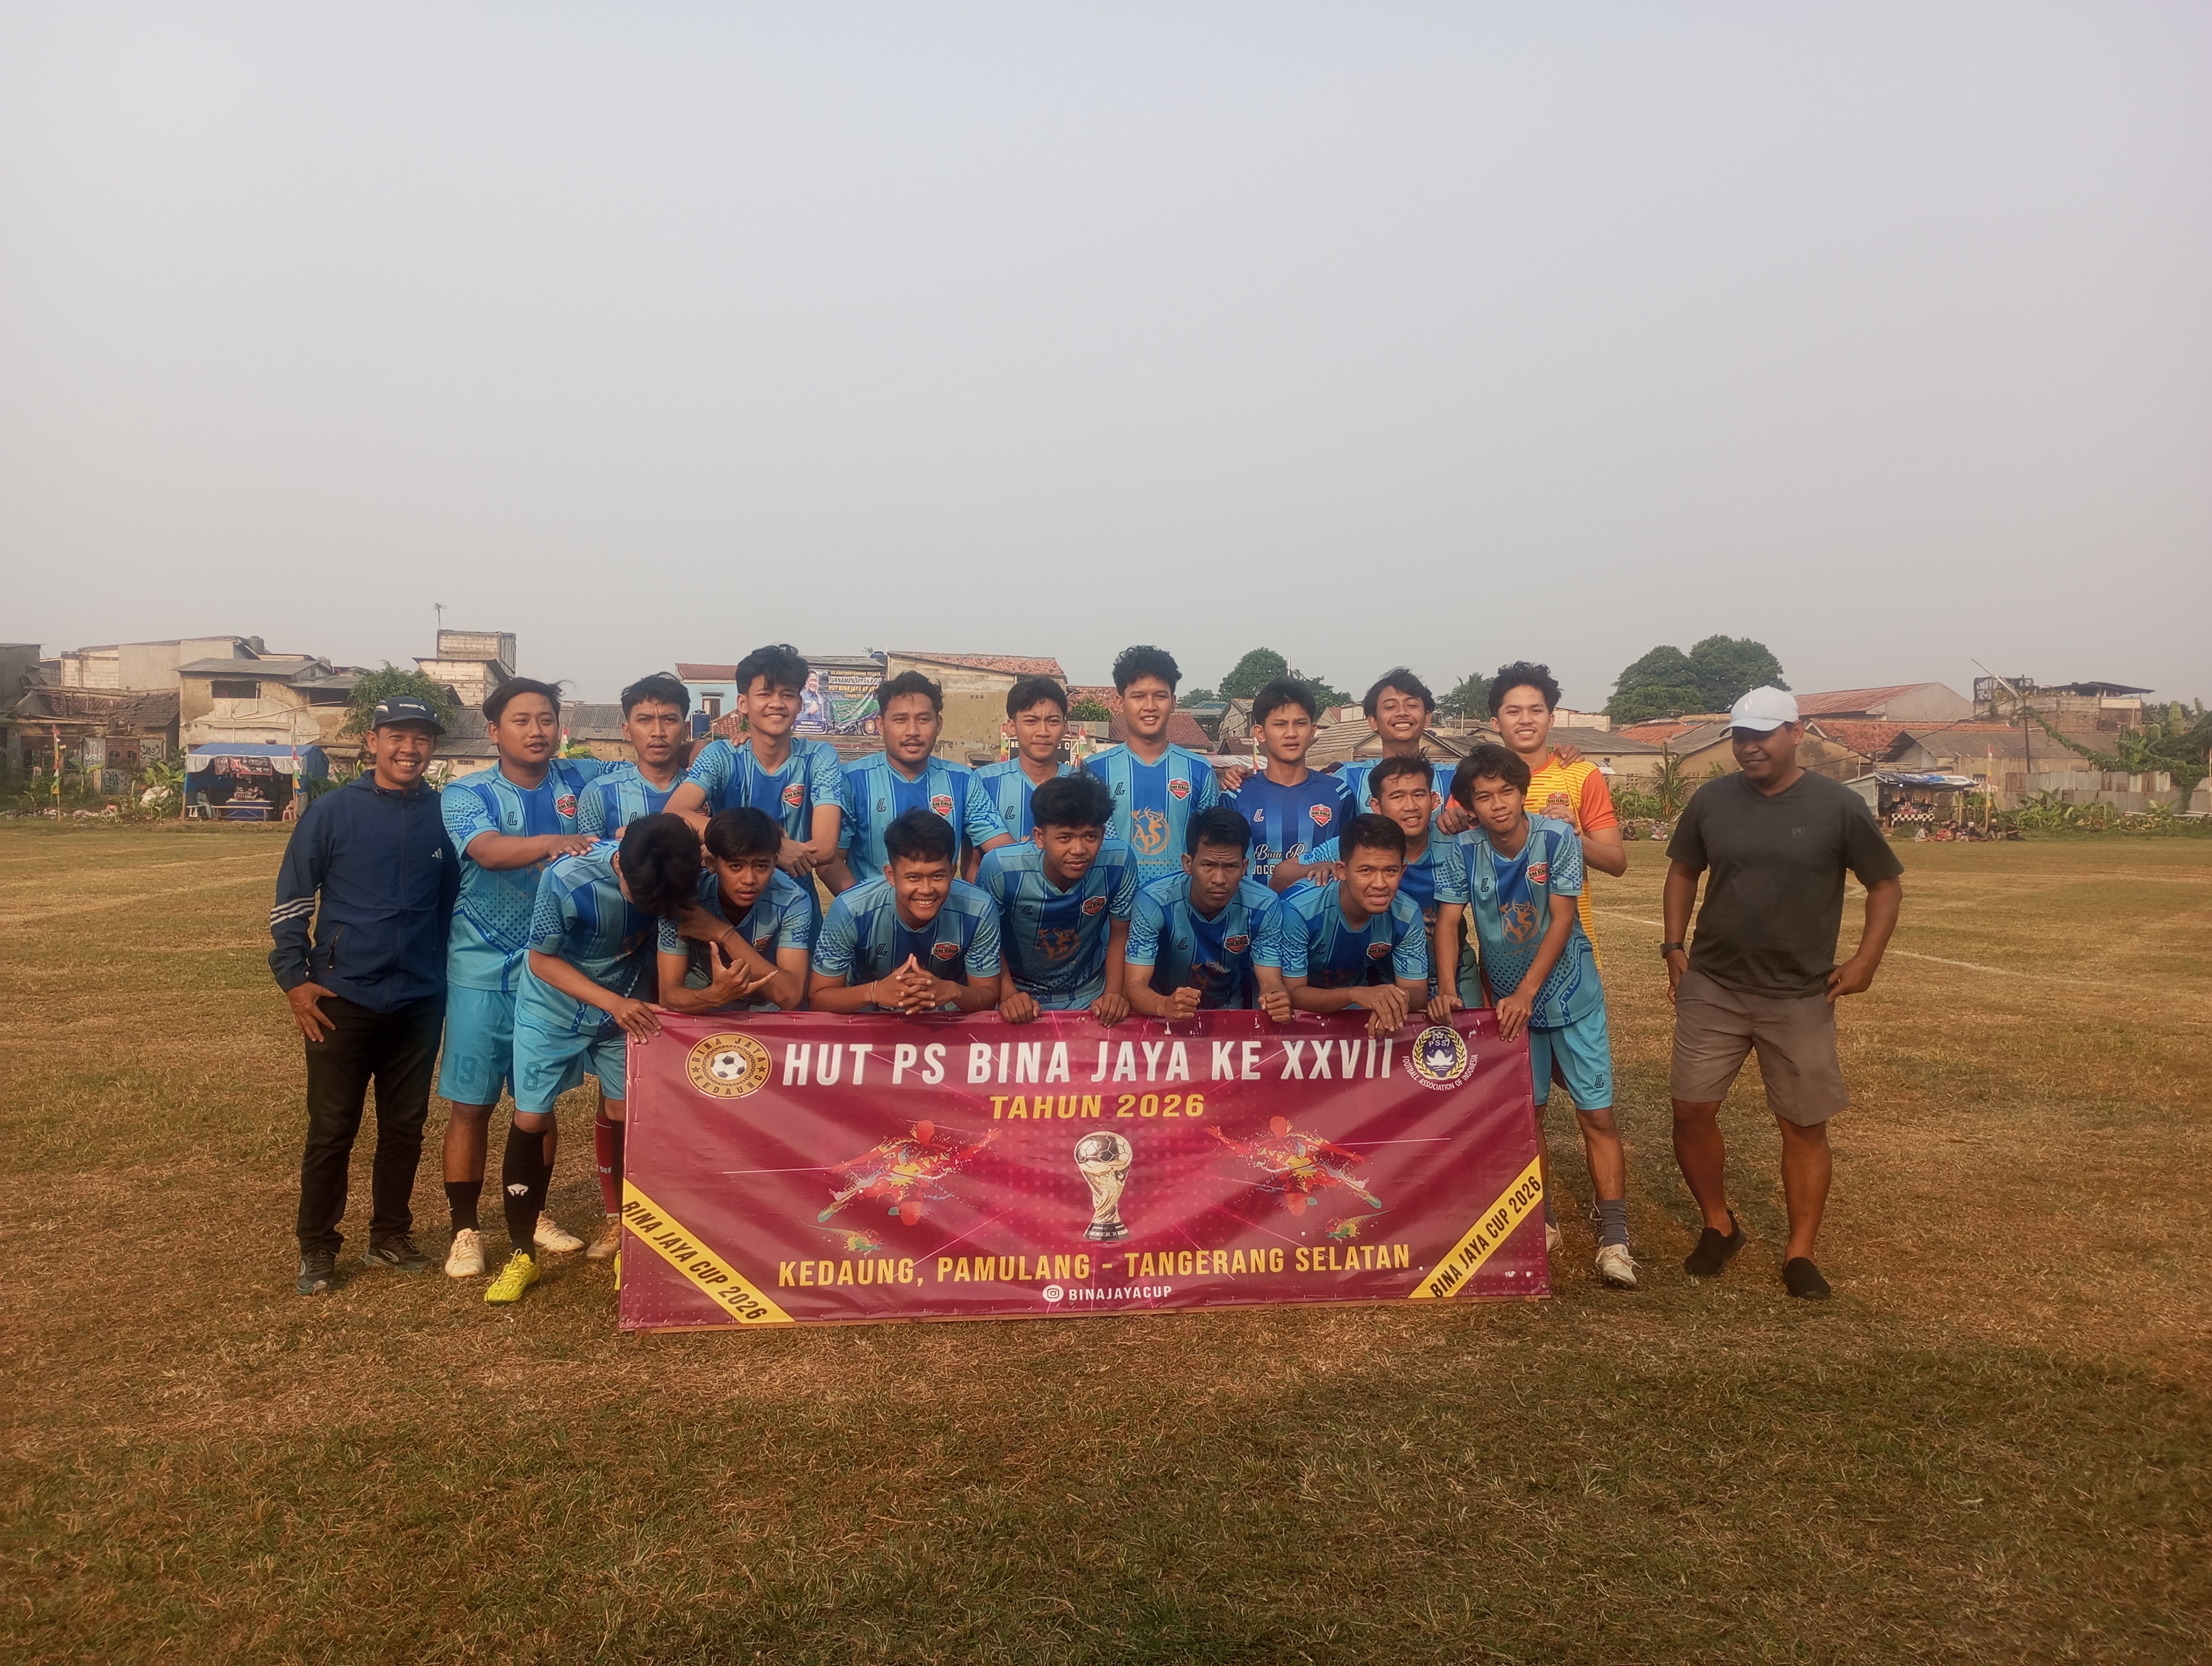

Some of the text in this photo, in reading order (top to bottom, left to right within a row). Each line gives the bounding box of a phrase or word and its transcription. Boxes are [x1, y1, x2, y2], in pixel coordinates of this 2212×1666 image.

[691, 1037, 766, 1062] BINA JAYA
[782, 1039, 1393, 1086] HUT PS BINA JAYA KE XXVII
[523, 1061, 542, 1091] 8
[694, 1074, 763, 1095] KEDAUNG
[1402, 1054, 1478, 1091] FOOTBALL ASSOCIATION OF INDONESIA
[989, 1093, 1205, 1119] TAHUN 2026
[1429, 1175, 1541, 1298] BINA JAYA CUP 2026
[622, 1200, 768, 1319] BINA JAYA CUP 2026
[778, 1258, 923, 1287] KEDAUNG,
[937, 1253, 1090, 1283] PAMULANG
[1124, 1248, 1284, 1278] TANGERANG
[1295, 1244, 1409, 1272] SELATAN
[1069, 1286, 1172, 1300] BINAJAYACUP
